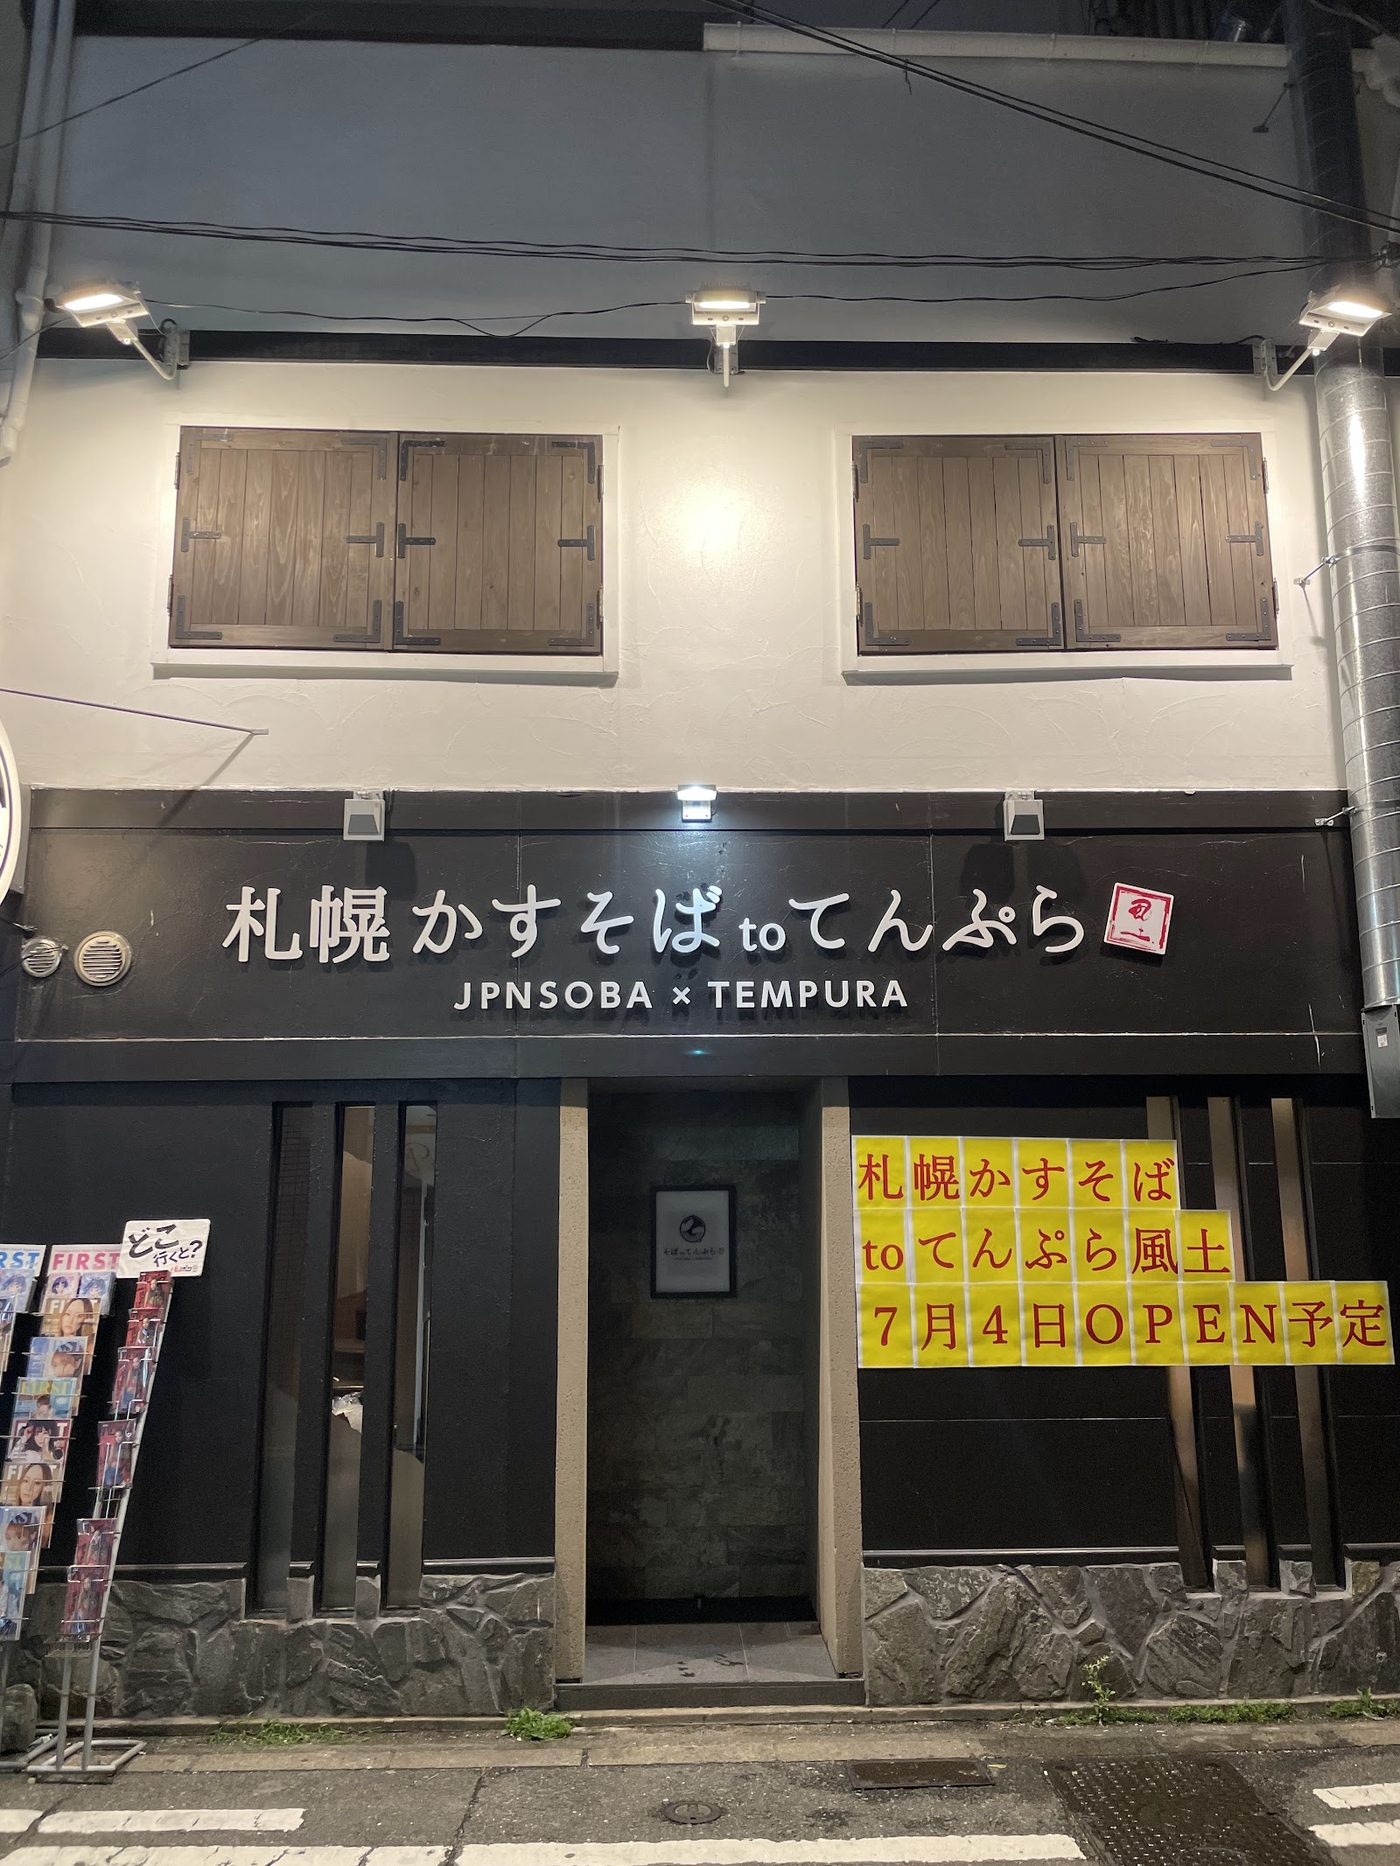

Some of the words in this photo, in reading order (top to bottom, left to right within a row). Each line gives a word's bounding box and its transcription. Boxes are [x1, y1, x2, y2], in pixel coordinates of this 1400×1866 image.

[453, 981, 653, 1011] JPNSOBA
[707, 980, 908, 1009] TEMPURA
[858, 1153, 1176, 1202] 札幌かすそば
[52, 1251, 121, 1271] FIRST
[128, 1223, 179, 1258] どこ
[862, 1227, 1231, 1275] toてんぷら風土
[873, 1298, 1388, 1351] 7月4日OPEN予定
